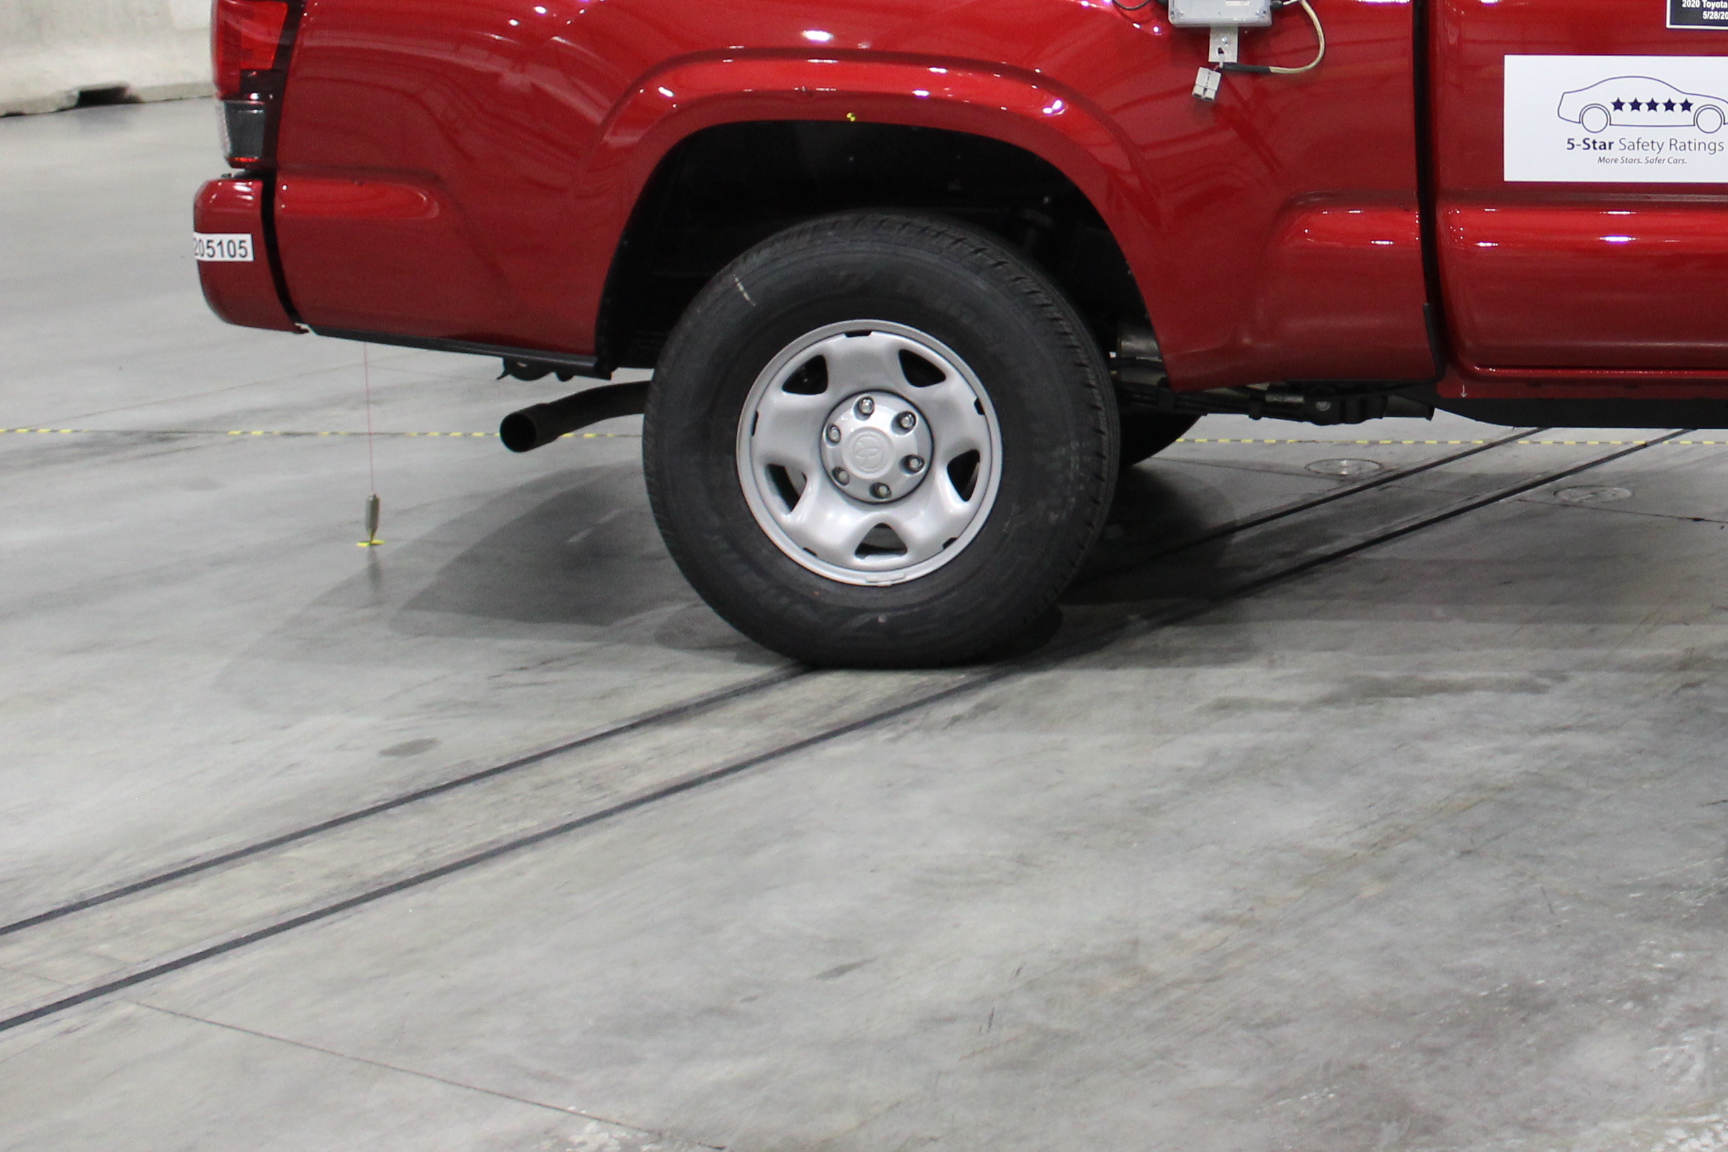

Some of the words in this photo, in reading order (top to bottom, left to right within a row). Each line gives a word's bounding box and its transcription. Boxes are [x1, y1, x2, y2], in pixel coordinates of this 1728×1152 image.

[1682, 0, 1700, 8] 2020
[1702, 0, 1728, 10] Toyota
[1566, 137, 1615, 152] 5-Star
[1618, 137, 1664, 154] Safety
[1669, 137, 1725, 154] Ratings
[1597, 156, 1618, 164] More
[1619, 156, 1642, 164] Stars.
[1644, 156, 1665, 164] Safer
[1667, 156, 1688, 164] Cars.
